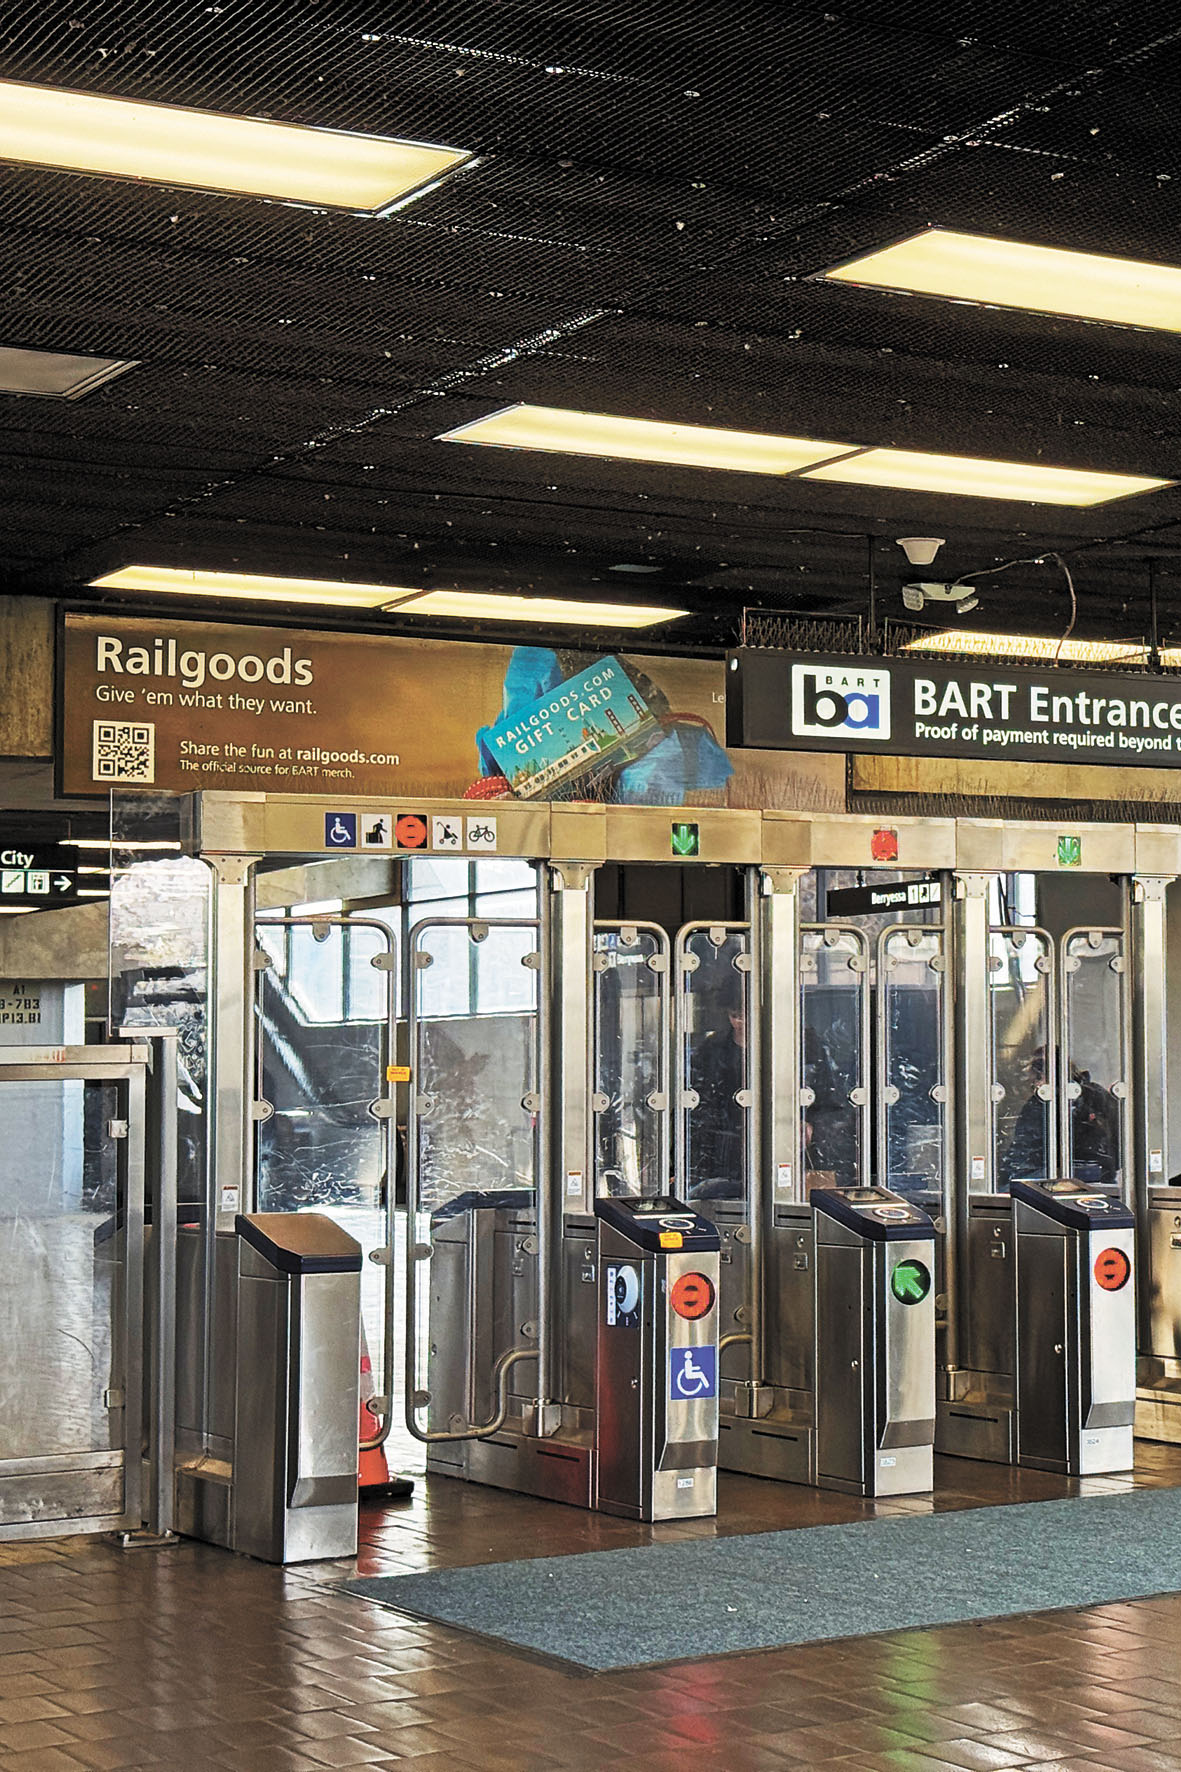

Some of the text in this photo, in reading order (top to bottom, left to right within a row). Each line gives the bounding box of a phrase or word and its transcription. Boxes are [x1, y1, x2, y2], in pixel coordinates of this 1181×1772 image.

[96, 636, 314, 689] Railgoods
[825, 676, 881, 688] BART
[96, 685, 135, 703] Give
[179, 690, 223, 709] what
[228, 693, 266, 714] they
[270, 698, 318, 715] want.
[495, 667, 616, 749] RAILGOODS.COM
[914, 679, 1018, 720] BART
[514, 687, 613, 755] GIFT CARD
[915, 721, 959, 740] Proof
[962, 723, 980, 740] of
[983, 727, 1049, 746] payment
[1053, 730, 1115, 750] required
[1119, 731, 1172, 752] beyond
[180, 740, 400, 766] Share the fun at railgoods.com
[180, 760, 200, 771] The
[202, 760, 236, 774] official
[238, 763, 272, 774] source
[274, 764, 290, 775] for
[322, 766, 355, 779] merch.
[0, 849, 35, 869] City
[871, 891, 907, 907] Berryessa
[0, 1012, 41, 1024] P13.81
